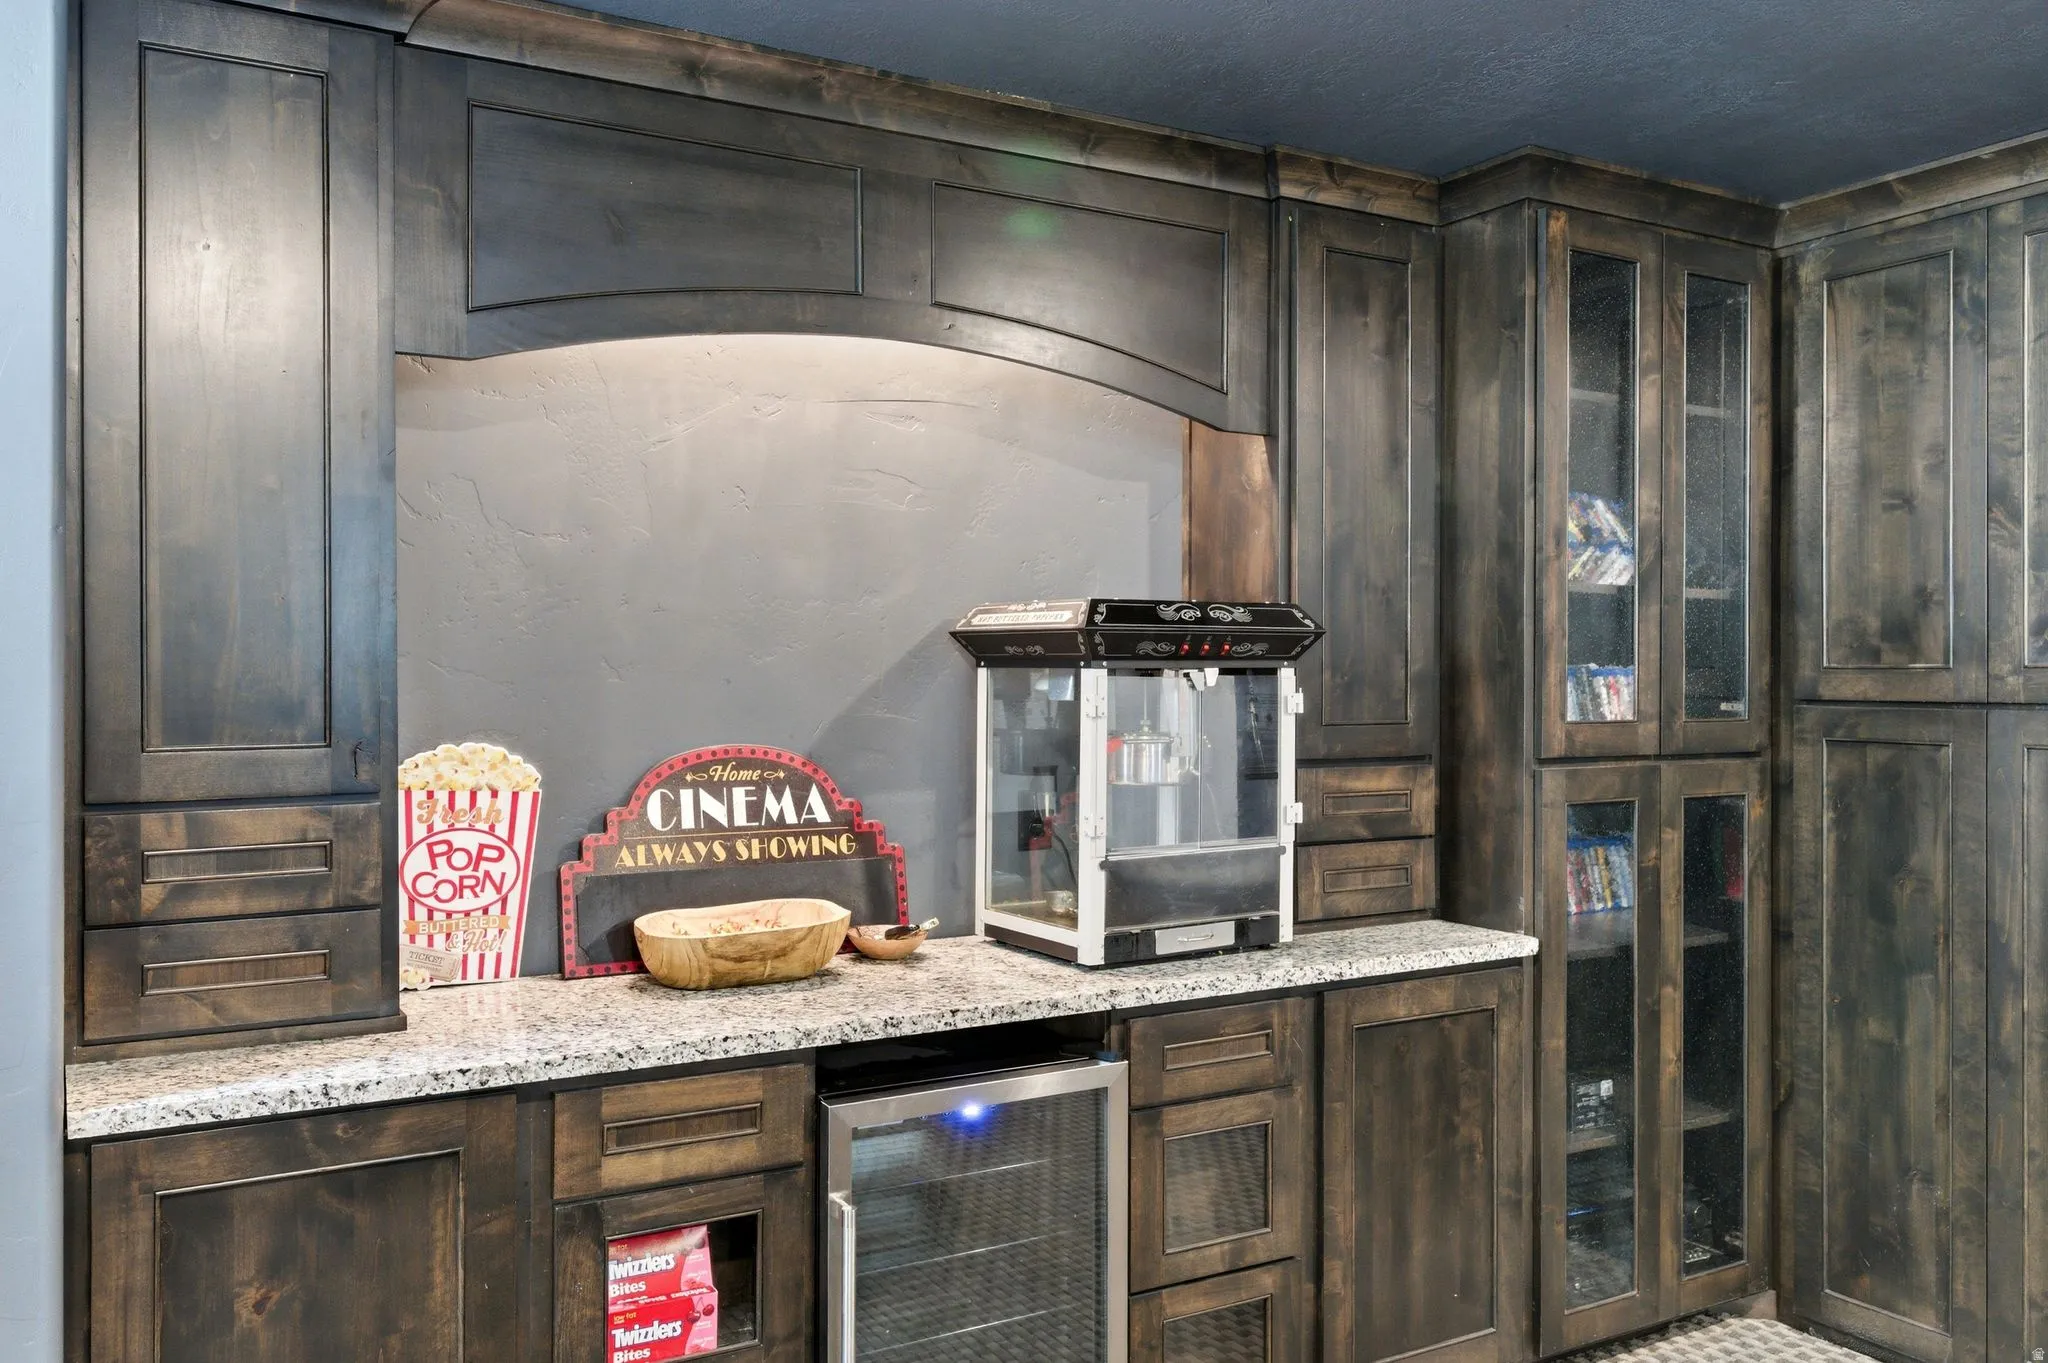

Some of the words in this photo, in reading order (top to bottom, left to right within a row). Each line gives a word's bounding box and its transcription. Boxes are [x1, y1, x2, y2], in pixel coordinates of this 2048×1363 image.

[709, 761, 760, 783] Home
[416, 798, 504, 825] Fresh
[647, 782, 832, 831] CINEMA
[426, 839, 505, 872] POP
[614, 839, 727, 869] ALWAYS
[735, 833, 856, 862] SHOWING
[411, 869, 507, 904] CORN
[419, 915, 500, 934] BUTTERED
[446, 932, 459, 950] &
[463, 928, 507, 952] Hot!
[409, 950, 445, 965] TICKET
[608, 1252, 675, 1281] Twizzlers
[609, 1281, 647, 1299] Bites
[611, 1320, 682, 1348] Twizzlers
[613, 1348, 651, 1363] Bites
